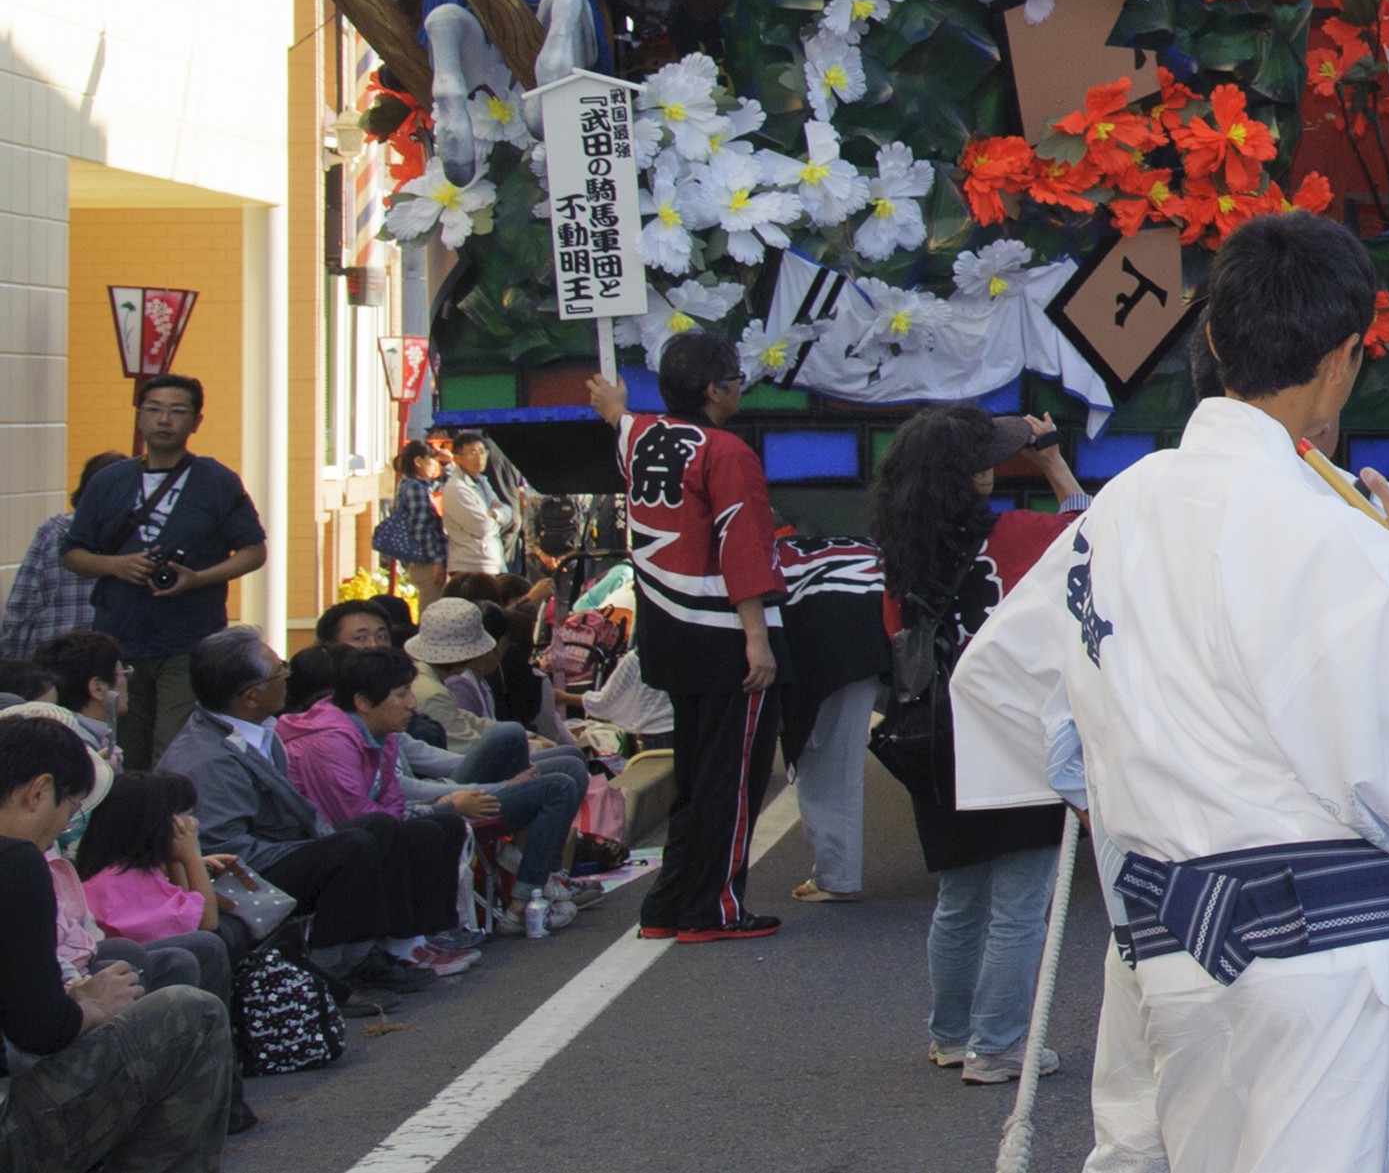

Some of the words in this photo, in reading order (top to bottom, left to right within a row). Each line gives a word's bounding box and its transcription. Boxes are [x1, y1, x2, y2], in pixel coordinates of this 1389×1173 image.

[609, 88, 631, 159] 戦国最強
[555, 193, 594, 316] 不動明王』
[579, 94, 624, 299] 『武田の騎馬軍団と
